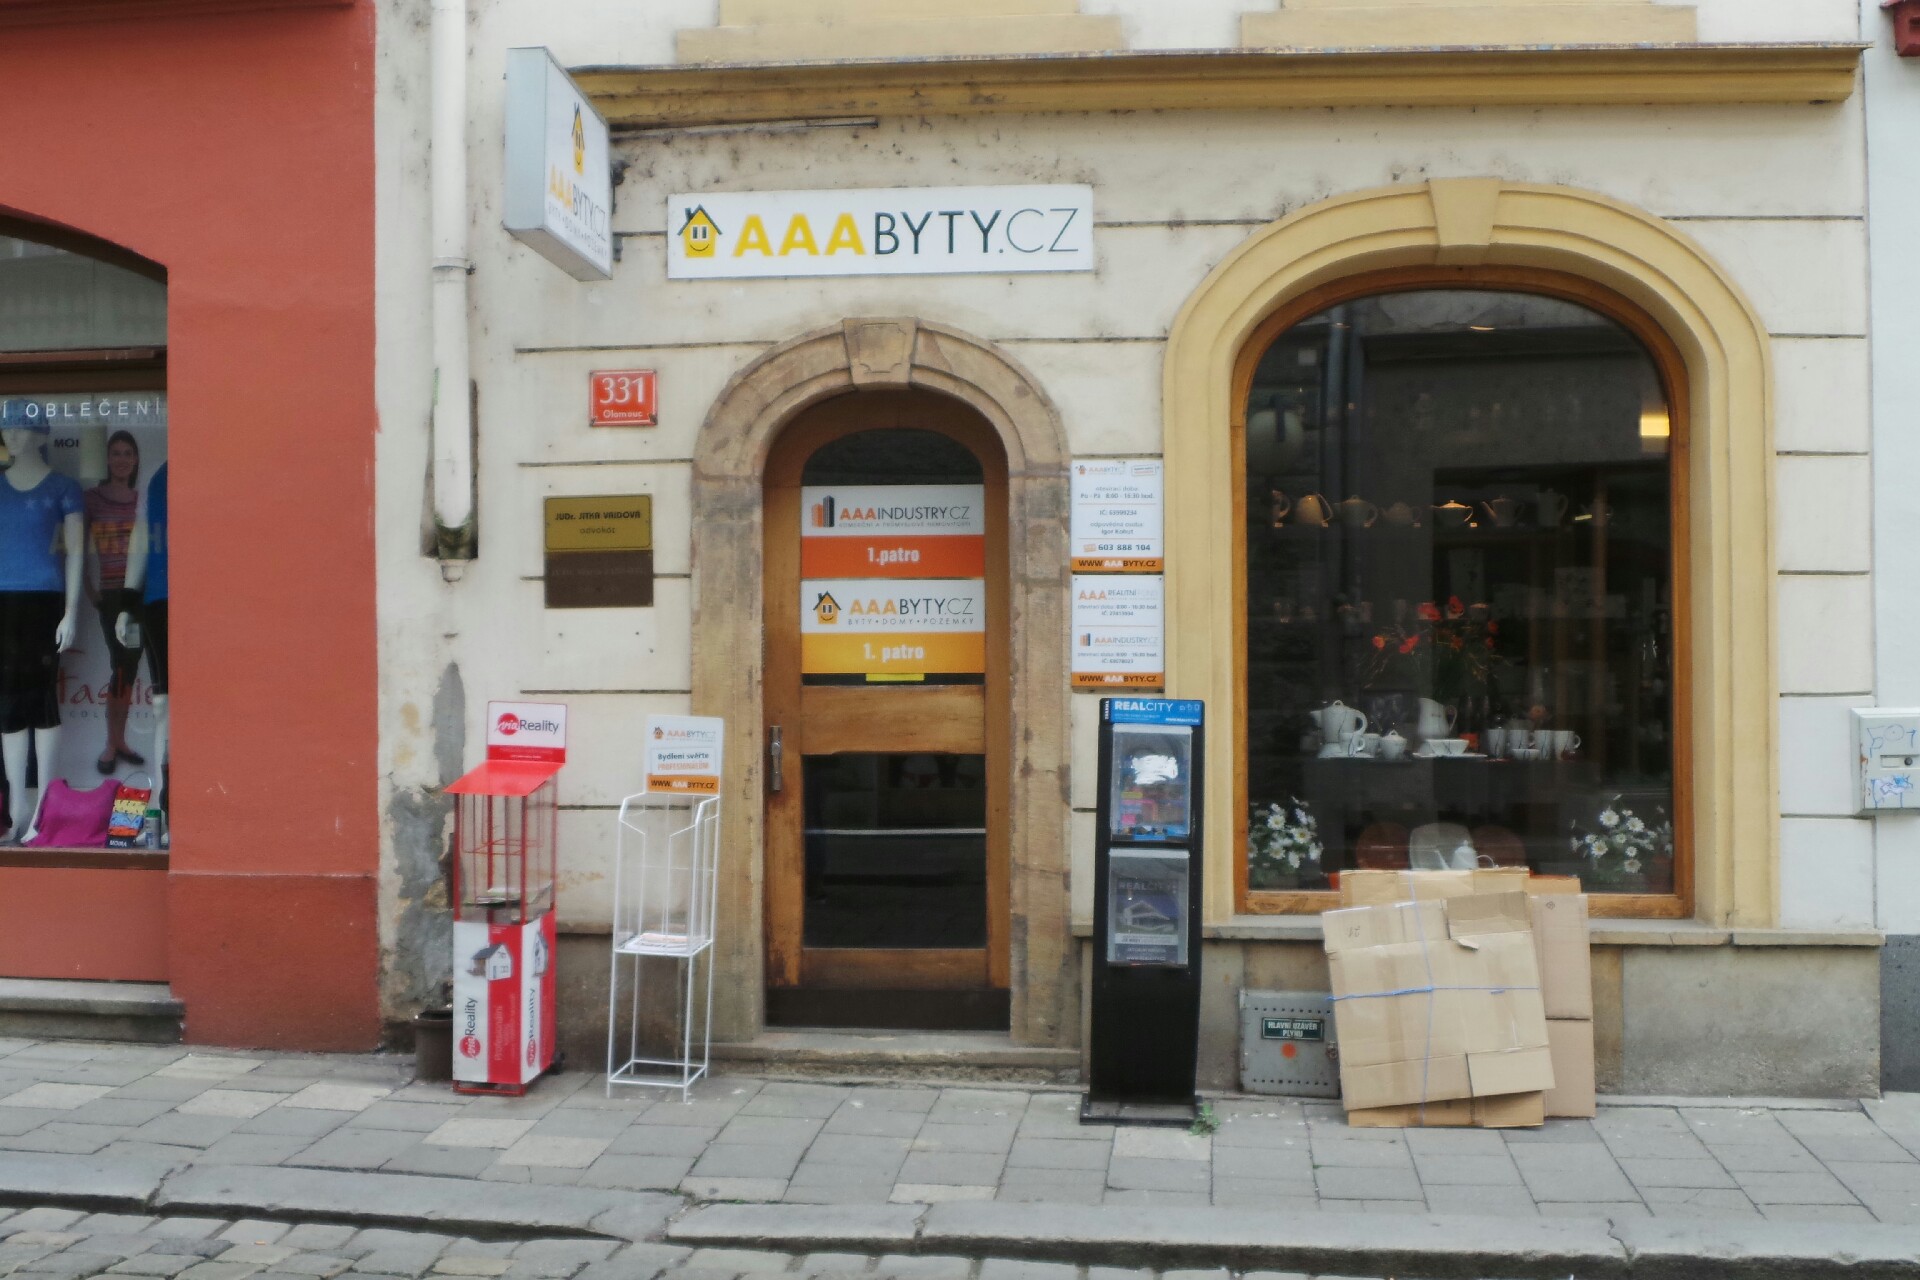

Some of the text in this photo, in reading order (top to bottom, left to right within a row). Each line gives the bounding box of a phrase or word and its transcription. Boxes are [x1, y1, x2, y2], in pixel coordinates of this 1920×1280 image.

[732, 207, 1079, 257] AAABYTY.CZ
[599, 376, 644, 403] 331
[25, 397, 160, 417] OBLEČENÍ
[603, 409, 643, 419] Olomouc
[555, 512, 576, 521] JUDr.
[839, 506, 971, 520] AAAINDUSTRY.CZ
[1098, 543, 1151, 551] 603 888 104
[867, 547, 921, 566] 1.patro
[849, 598, 974, 616] AAABYTY.CZ
[882, 618, 914, 626] DOMY
[923, 617, 974, 625] POZEMKY
[882, 644, 925, 663] patro
[1114, 700, 1174, 712] REALCITY
[519, 719, 560, 735] Reality
[464, 997, 478, 1036] Reality
[1267, 1021, 1290, 1030] HLAVNÍ
[1282, 1029, 1304, 1038] PLYNU
